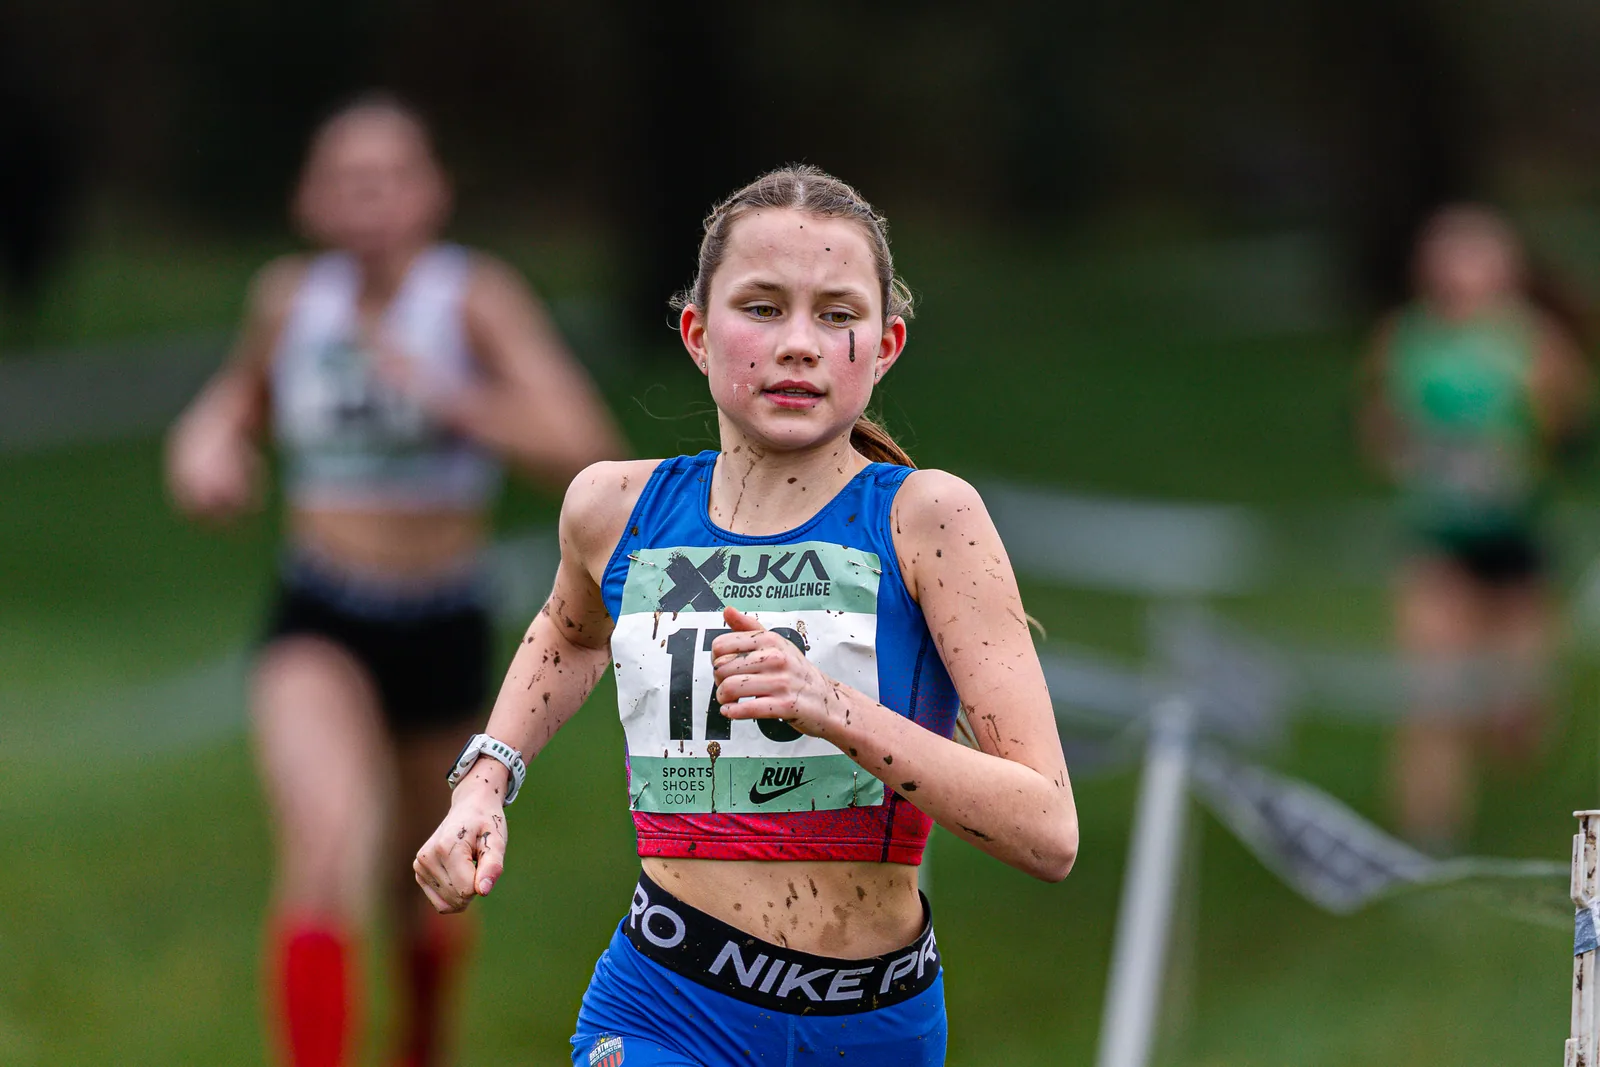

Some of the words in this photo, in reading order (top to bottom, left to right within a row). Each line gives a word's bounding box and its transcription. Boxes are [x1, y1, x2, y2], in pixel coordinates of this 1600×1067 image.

[727, 550, 831, 584] UKA
[723, 584, 763, 598] CROSS
[765, 582, 830, 599] CHALLENGE
[662, 767, 713, 778] SPORTS
[759, 766, 805, 787] RUN
[662, 780, 705, 791] SHOES
[662, 793, 696, 805] .COM
[708, 940, 875, 1001] NIKE
